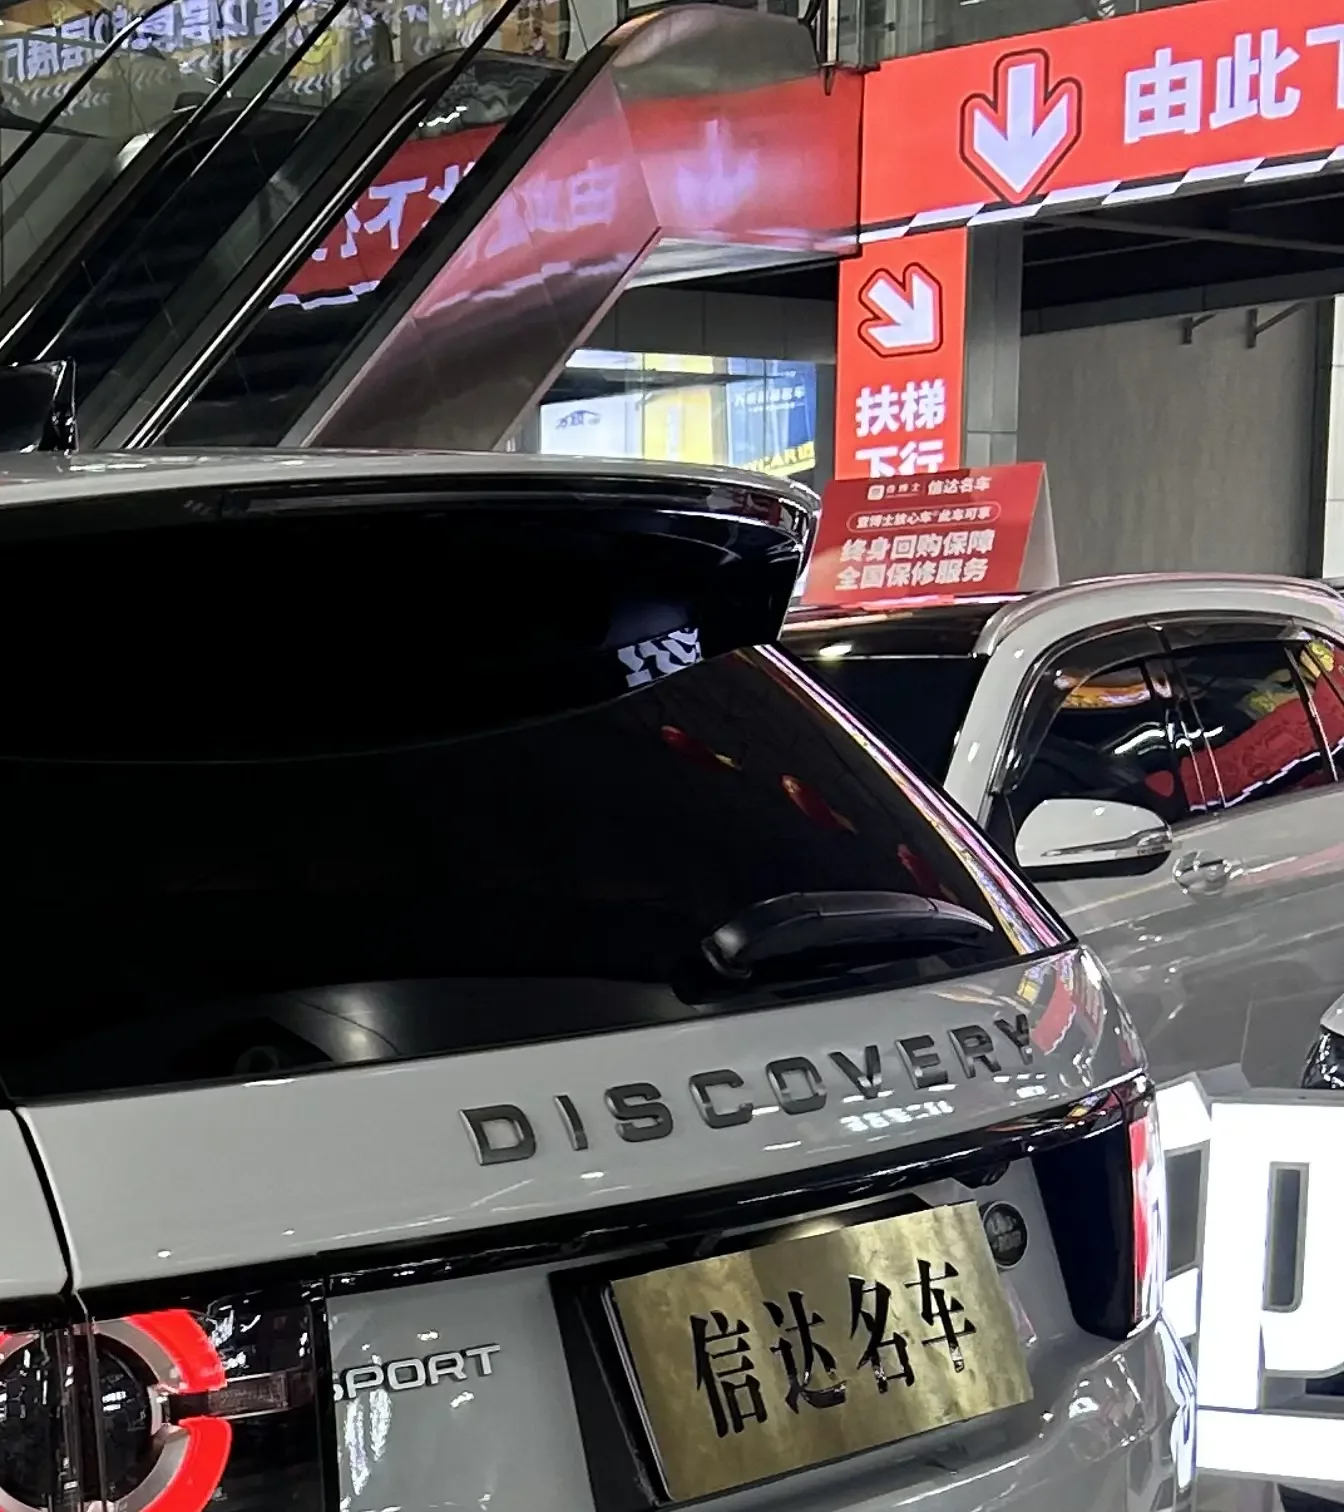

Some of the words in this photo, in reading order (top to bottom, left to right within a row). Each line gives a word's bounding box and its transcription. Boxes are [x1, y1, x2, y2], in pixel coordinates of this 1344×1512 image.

[854, 379, 946, 438] 扶梯
[458, 1012, 1033, 1167] DISCOVERY
[689, 1258, 977, 1438] 信达名车
